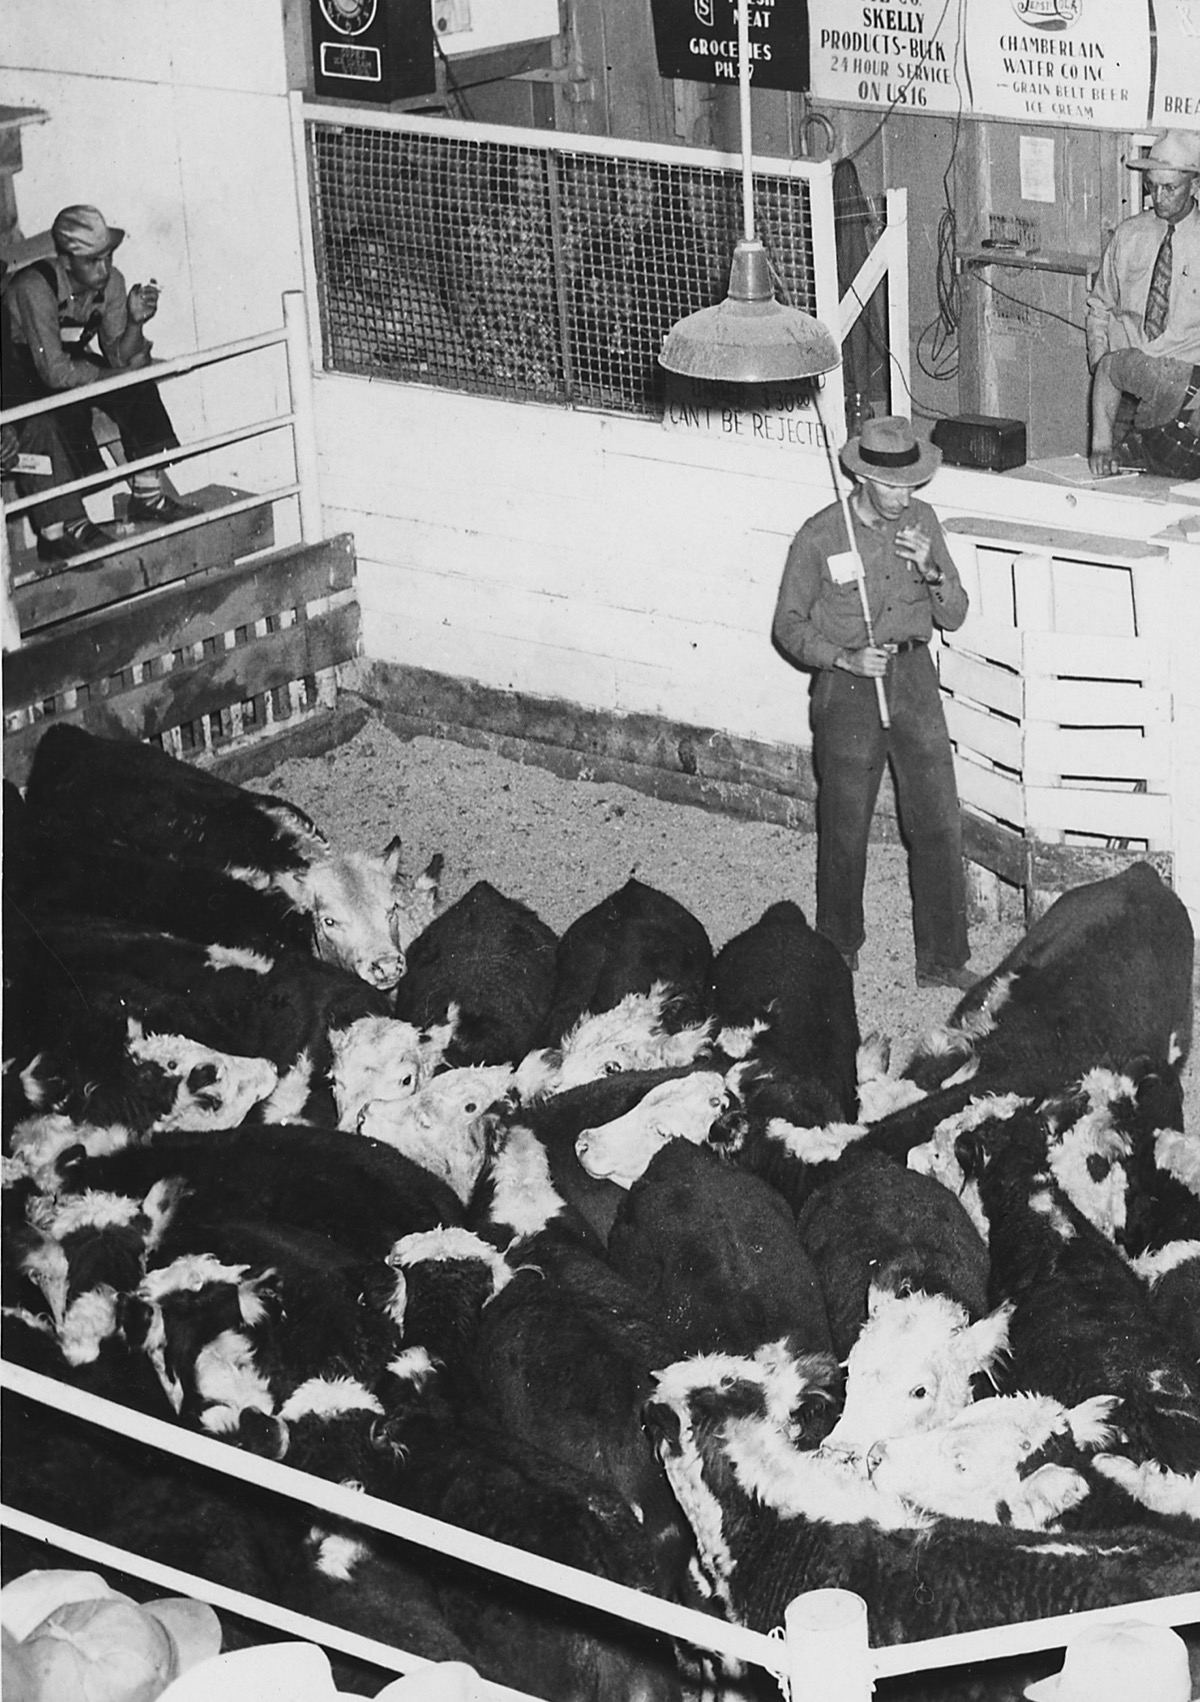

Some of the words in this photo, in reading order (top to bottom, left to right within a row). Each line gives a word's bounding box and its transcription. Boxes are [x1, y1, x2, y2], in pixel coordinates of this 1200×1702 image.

[863, 7, 925, 34] SKELLY
[689, 37, 772, 61] GROCEIES
[821, 29, 946, 62] PRODUCTS-BULK
[1000, 35, 1105, 59] CHAMBERLAIN
[830, 55, 848, 72] 24
[853, 58, 889, 76] HOUR
[898, 63, 951, 85] SERVICE
[1003, 58, 1054, 77] WATER
[1061, 63, 1078, 80] CO
[1084, 65, 1105, 81] INC
[858, 80, 881, 101] ON
[1013, 81, 1050, 96] GRAIN
[1056, 85, 1085, 99] BELT
[1091, 88, 1128, 101] BEER
[1026, 101, 1043, 113] ICE
[1051, 103, 1094, 118] CREAM
[722, 408, 744, 436] BE
